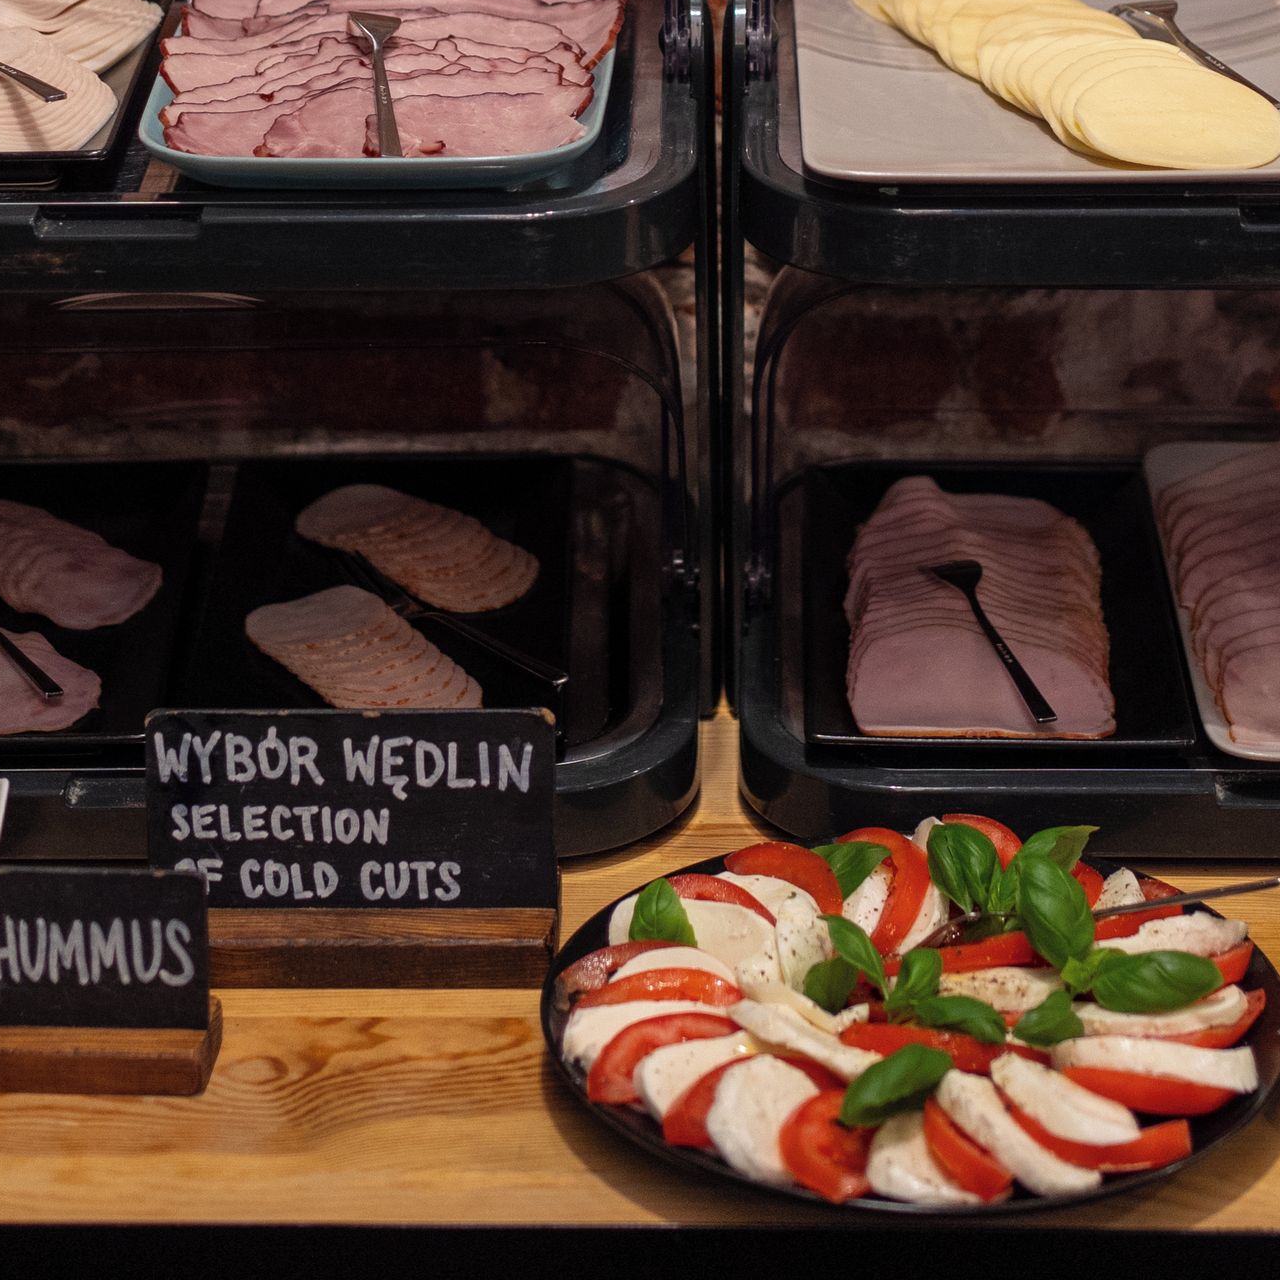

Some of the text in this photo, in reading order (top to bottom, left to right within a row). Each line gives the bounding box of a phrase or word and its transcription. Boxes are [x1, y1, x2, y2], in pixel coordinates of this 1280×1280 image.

[154, 726, 534, 801] WYBÓR WĘDLIN
[171, 804, 390, 845] SELECTION
[239, 859, 339, 901] COLD
[359, 860, 462, 902] CUTS
